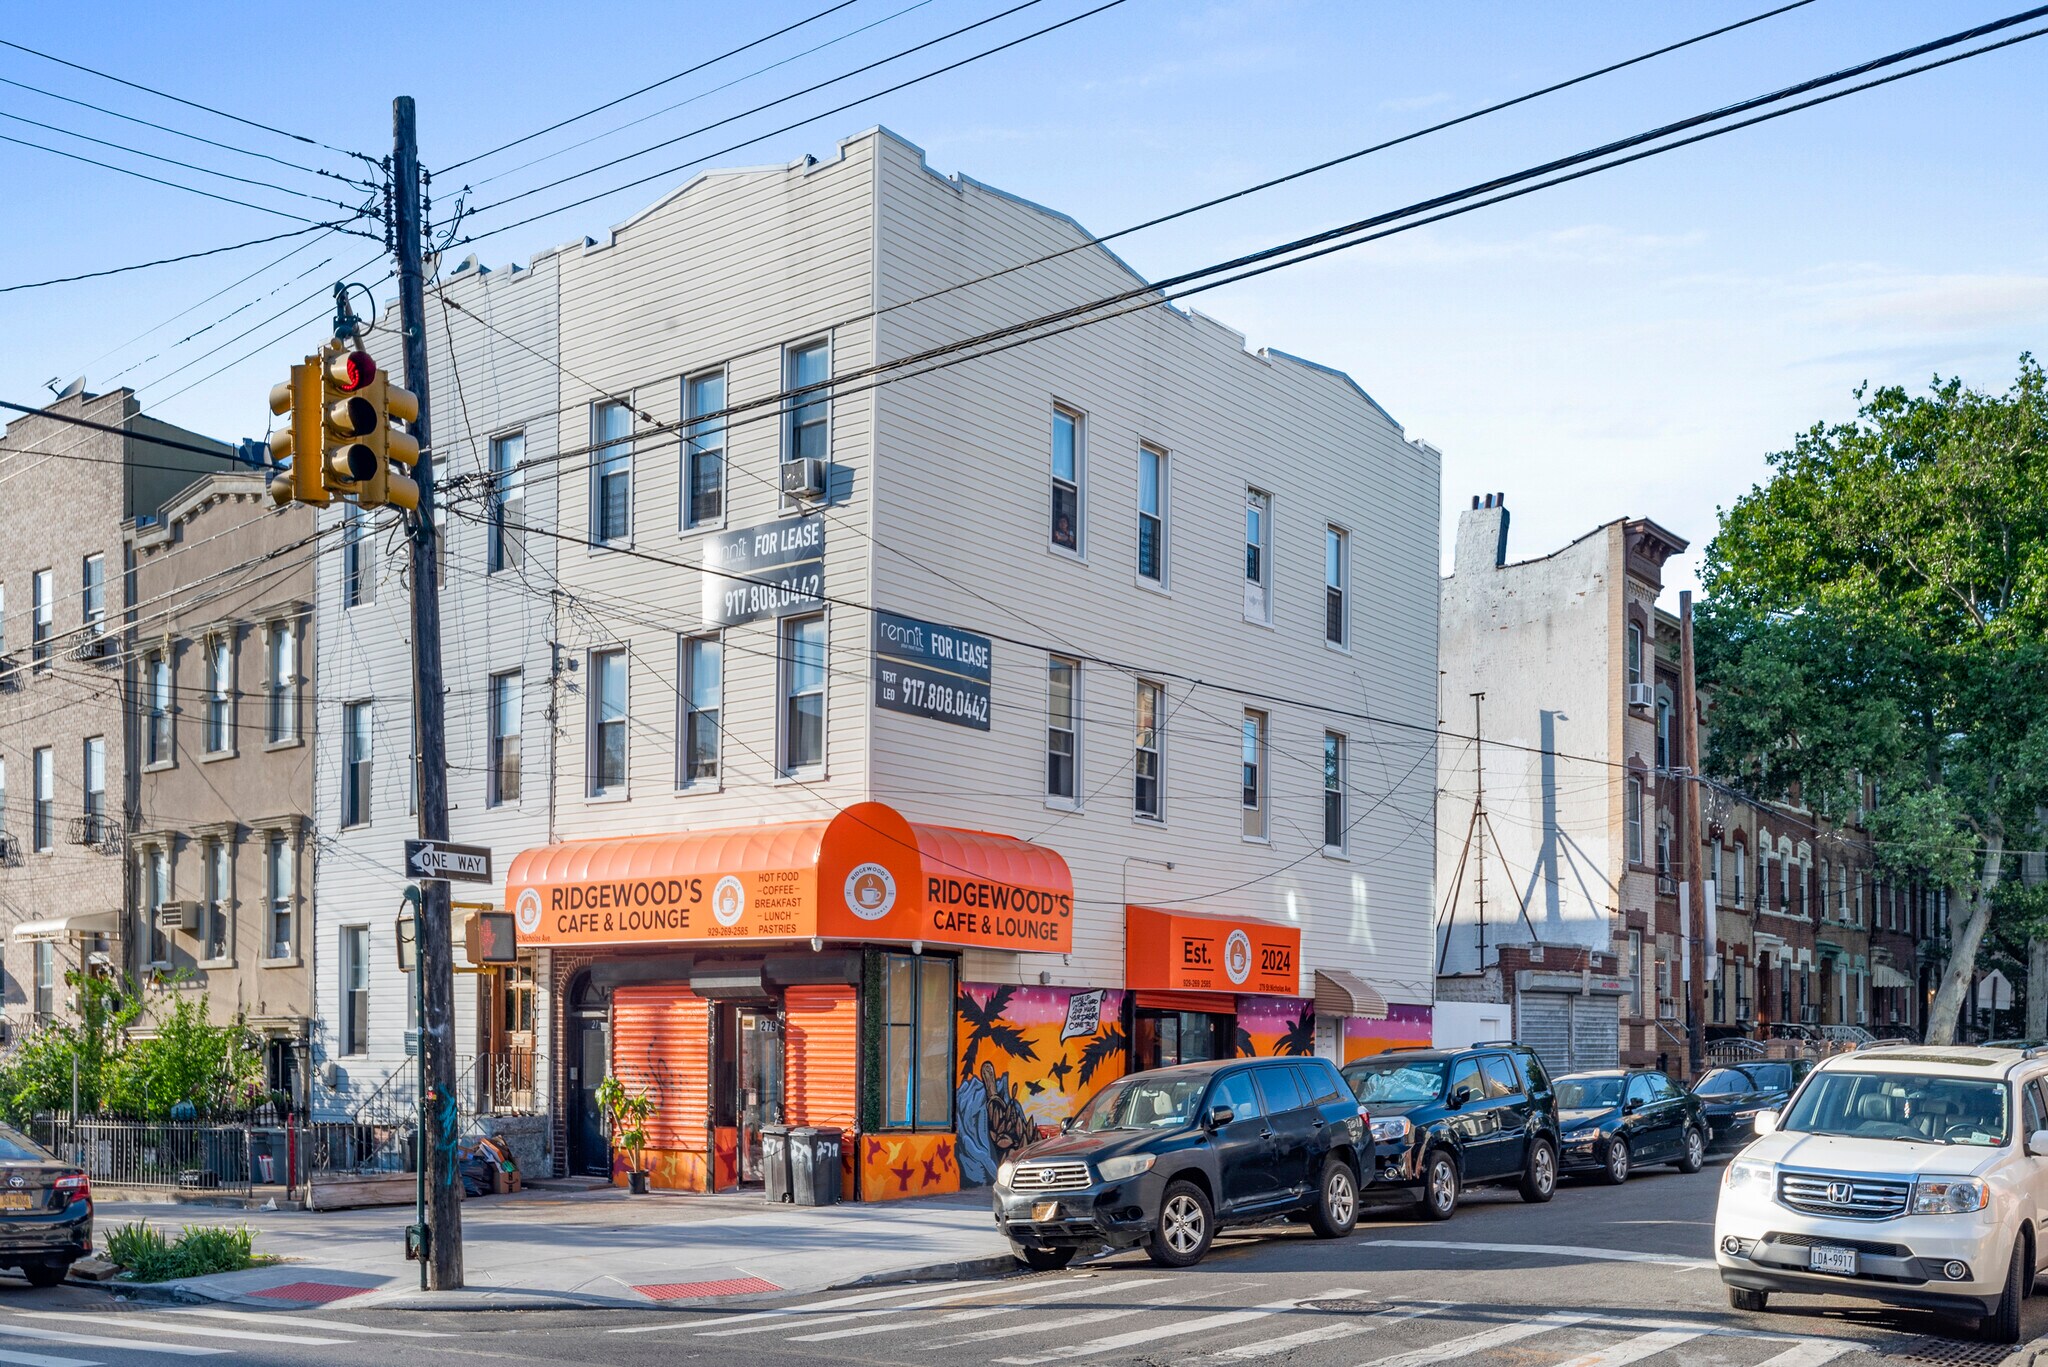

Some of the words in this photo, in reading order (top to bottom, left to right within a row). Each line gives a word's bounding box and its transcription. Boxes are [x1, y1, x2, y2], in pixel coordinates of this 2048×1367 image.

[754, 534, 777, 557] FOR
[781, 522, 818, 552] LEASE
[726, 574, 819, 617] 917.808.0442
[881, 622, 924, 648] rennit
[931, 633, 953, 659] FOR
[956, 640, 988, 669] LEASE
[882, 670, 896, 684] TEXT
[883, 688, 895, 700] LEO
[902, 677, 987, 722] 917.808.0442
[422, 852, 448, 868] ONE
[458, 855, 480, 871] WAY
[758, 873, 775, 883] HOT
[777, 872, 799, 882] FOOD
[850, 866, 889, 880] RIDGEWOOD'S
[552, 879, 702, 911] RIDGEWOOD'S
[762, 884, 794, 895] COFFEE
[928, 878, 1070, 918] RIDGEWOOD'S
[755, 897, 802, 909] BREAKFAST
[557, 911, 599, 934] CAFE
[603, 914, 614, 931] &
[619, 909, 690, 930] LOUNGE
[764, 911, 791, 921] LUNCH
[933, 910, 976, 934] CAFE
[981, 918, 991, 934] &
[996, 916, 1058, 941] LOUNGE
[708, 927, 748, 936] 929-269-2585
[758, 924, 796, 934] PASTRIES
[1184, 941, 1211, 964] Est.
[1262, 949, 1290, 971] 2024
[761, 1021, 776, 1031] 279
